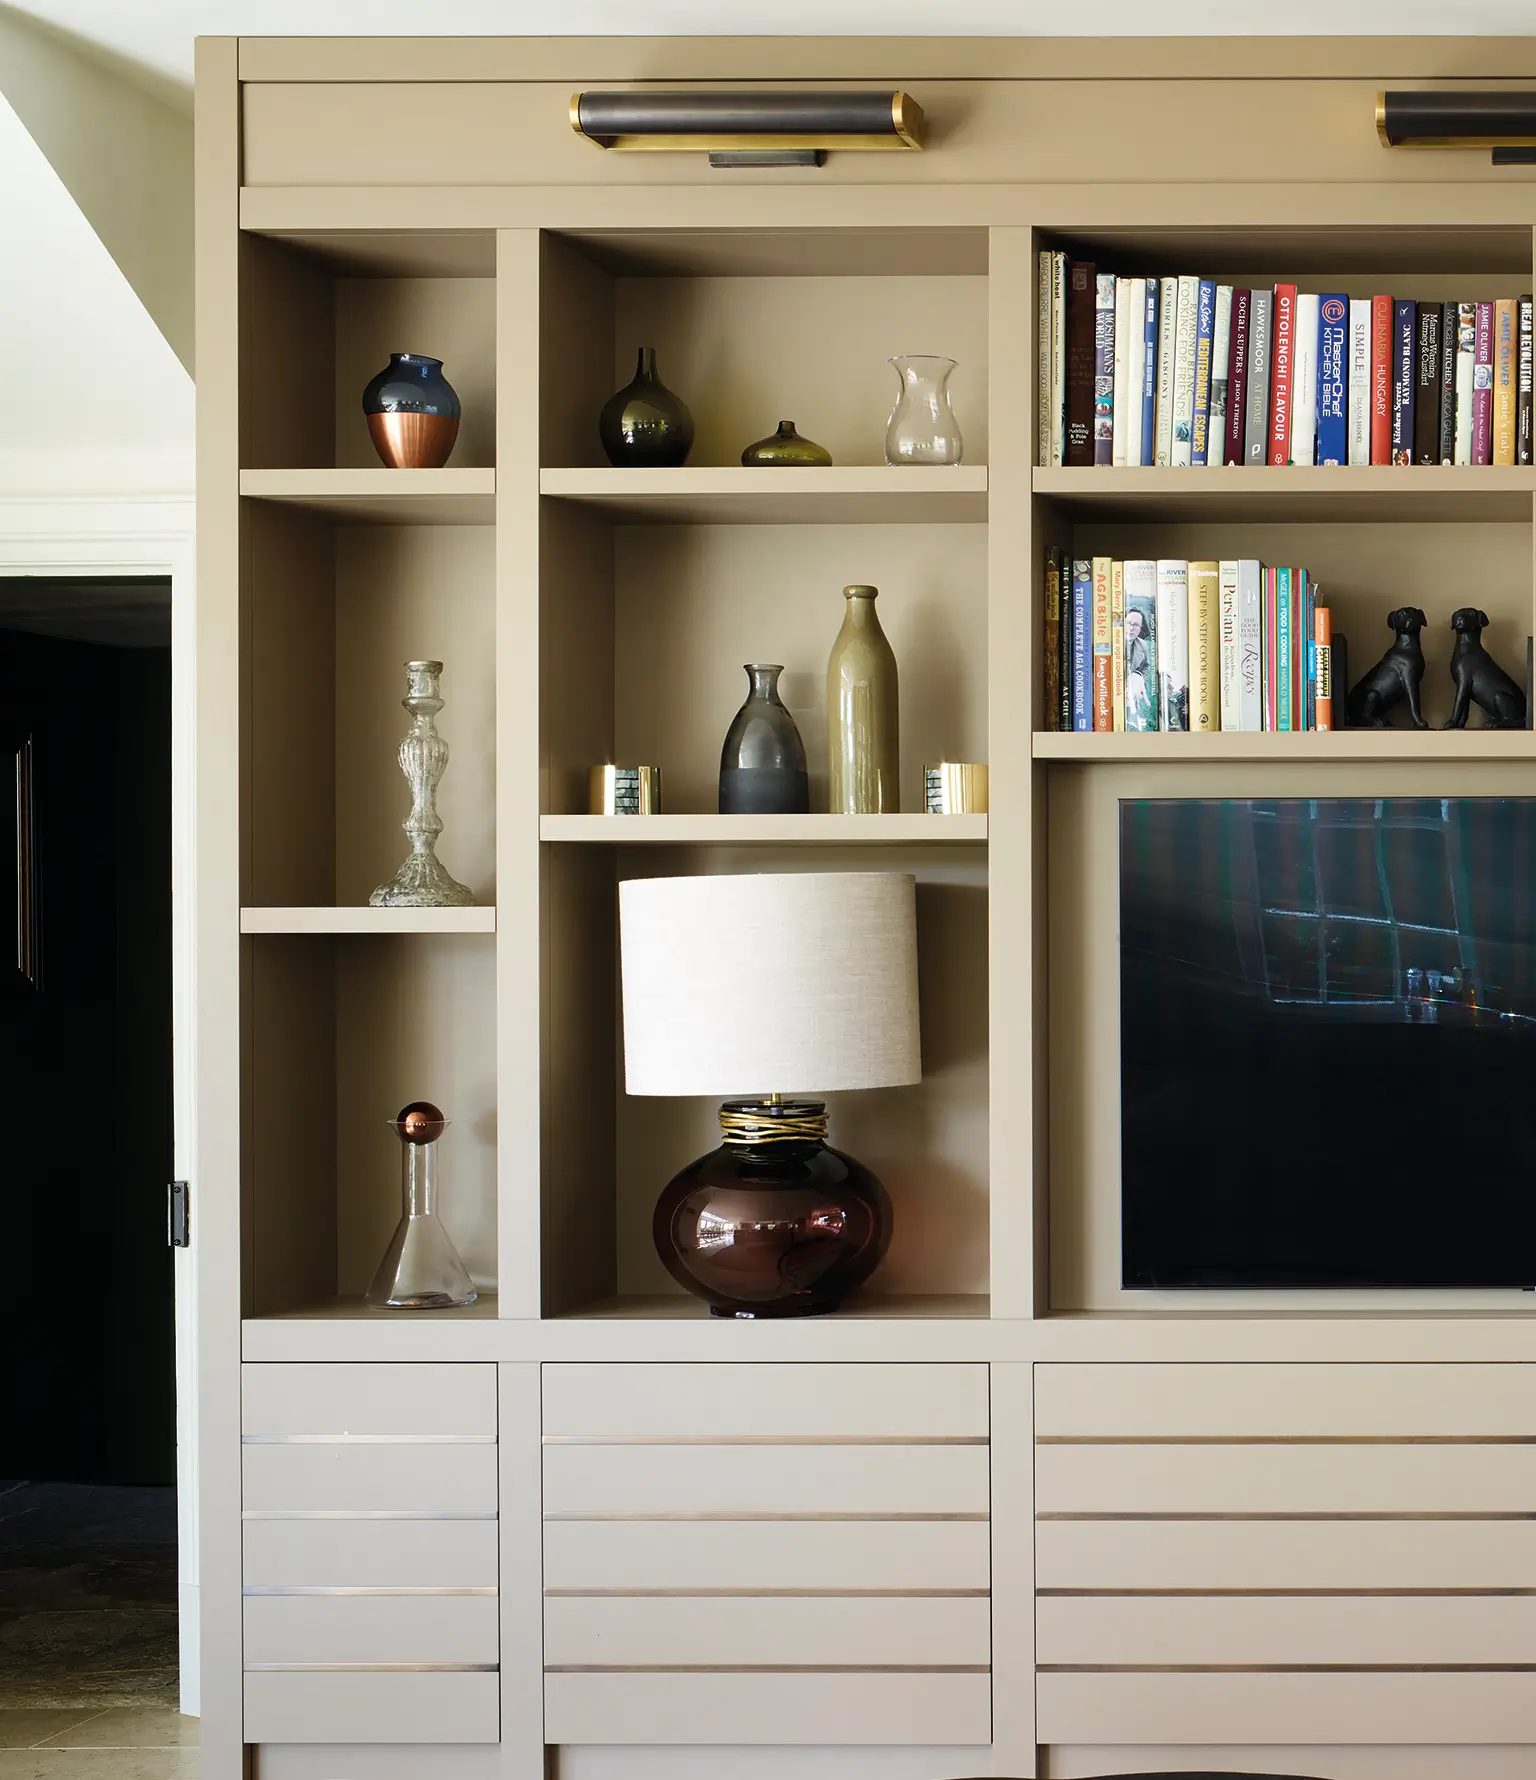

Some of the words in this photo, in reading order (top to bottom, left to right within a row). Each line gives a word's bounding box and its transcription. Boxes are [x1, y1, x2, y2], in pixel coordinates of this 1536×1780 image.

[1041, 257, 1049, 285] MARCO
[1164, 285, 1172, 340] MEMORIES
[1180, 281, 1190, 336] COOKING
[1481, 304, 1489, 330] JAMIE
[1521, 302, 1533, 331] BREAD
[1041, 319, 1049, 346] WHITE
[1095, 312, 1105, 348] WORLD
[1188, 303, 1197, 356] RAYMOND
[1254, 300, 1266, 373] HAWKSMOOR
[1277, 297, 1290, 379] OTTOLENGHI
[1377, 301, 1387, 361] CULINARIA
[1403, 324, 1411, 356] BLANC
[1420, 313, 1430, 346] Nutmeg
[1429, 314, 1438, 344] Marcus
[1501, 311, 1511, 343] JAMIE
[1179, 341, 1187, 362] FOR
[1323, 327, 1332, 380] KITCHEN
[1355, 324, 1365, 371] SIMPLE
[1421, 347, 1429, 355] &
[1428, 344, 1437, 378] Wareing
[1480, 332, 1489, 362] OLIVER
[1520, 334, 1532, 392] REVOLUTION
[1186, 360, 1195, 396] BLANC
[1196, 338, 1210, 410] MEDITERRANEAN
[1402, 357, 1411, 405] RAYMOND
[1421, 354, 1430, 386] Custard
[1500, 346, 1510, 386] OLIVER
[1176, 367, 1186, 416] FRIENDS
[1254, 382, 1262, 395] AT
[1323, 383, 1331, 417] BIBLE
[1376, 364, 1386, 417] HUNGARY
[1253, 396, 1262, 426] HOME
[1275, 384, 1287, 441] FLAVOUR
[1193, 414, 1206, 453] ESCAPES
[1076, 587, 1084, 605] THE
[1114, 590, 1122, 612] Berry
[1223, 584, 1237, 643] Persiana
[1076, 606, 1084, 651] COMPLETE
[1076, 652, 1084, 669] AGA
[1097, 657, 1108, 678] Amy
[1241, 643, 1259, 696] Recipes
[1076, 670, 1084, 715] COOKBOOK
[1099, 678, 1109, 716] Willcock
